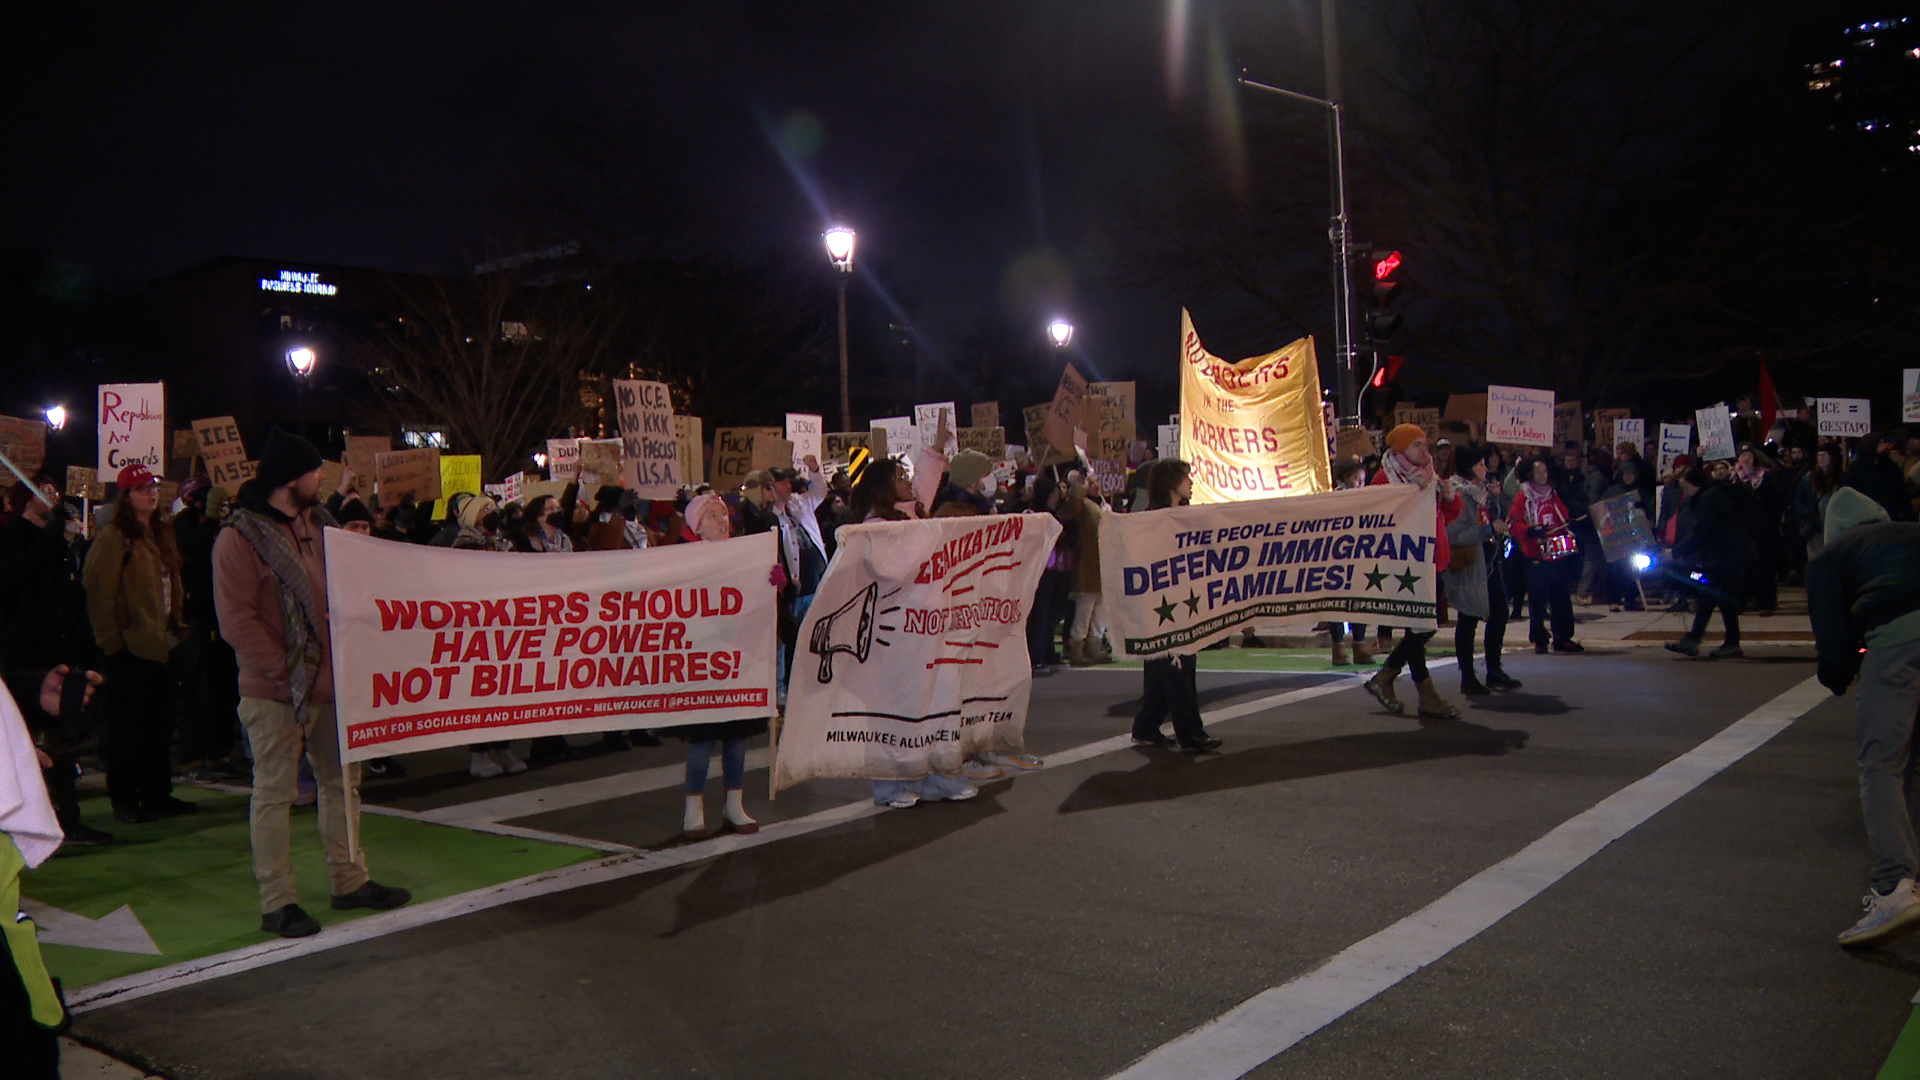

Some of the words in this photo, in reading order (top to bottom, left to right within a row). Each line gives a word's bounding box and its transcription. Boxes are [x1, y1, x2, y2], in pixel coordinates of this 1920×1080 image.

[618, 385, 635, 409] NO
[1203, 393, 1211, 408] IN
[1216, 399, 1235, 412] THE
[1821, 401, 1840, 414] ICE
[198, 425, 239, 447] ICE
[620, 411, 640, 433] NO
[643, 412, 669, 436] KKK
[793, 420, 816, 434] JESUS
[1192, 416, 1279, 454] WORKERS
[1819, 420, 1869, 433] GESTAPO
[108, 447, 159, 468] Cowards
[624, 437, 641, 459] NO
[213, 460, 251, 484] ASS
[637, 461, 677, 486] U.S.A.
[718, 456, 750, 477] ICE
[1191, 453, 1294, 493] STRUGGLE
[1175, 530, 1212, 550] THE
[1216, 522, 1289, 544] PEOPLE
[1290, 516, 1355, 536] UNITED
[1358, 513, 1398, 530] WILL
[1123, 540, 1252, 596] DEFEND
[1207, 563, 1356, 610] FAMILIES!
[374, 591, 590, 631] WORKERS
[598, 586, 744, 624] SHOULD
[904, 607, 949, 635] NOT
[1133, 637, 1169, 651] PARTY
[1169, 632, 1192, 646] FOR
[1295, 599, 1347, 611] MILWAUKEE
[430, 628, 555, 664] HAVE
[554, 622, 693, 658] POWER.
[372, 666, 460, 708] NOT
[470, 650, 741, 698] BILLIONAIRES!
[352, 726, 387, 742] PARTY
[390, 722, 413, 736] FOR
[416, 713, 481, 731] SOCIALISM
[484, 711, 509, 723] AND
[512, 703, 583, 721] LIBERATION
[593, 699, 660, 713] MILWAUKEE
[669, 692, 763, 708] @PSLMILWAUKEE
[827, 730, 897, 746] MILWAUKEE
[900, 729, 949, 749] ALLIANCE
